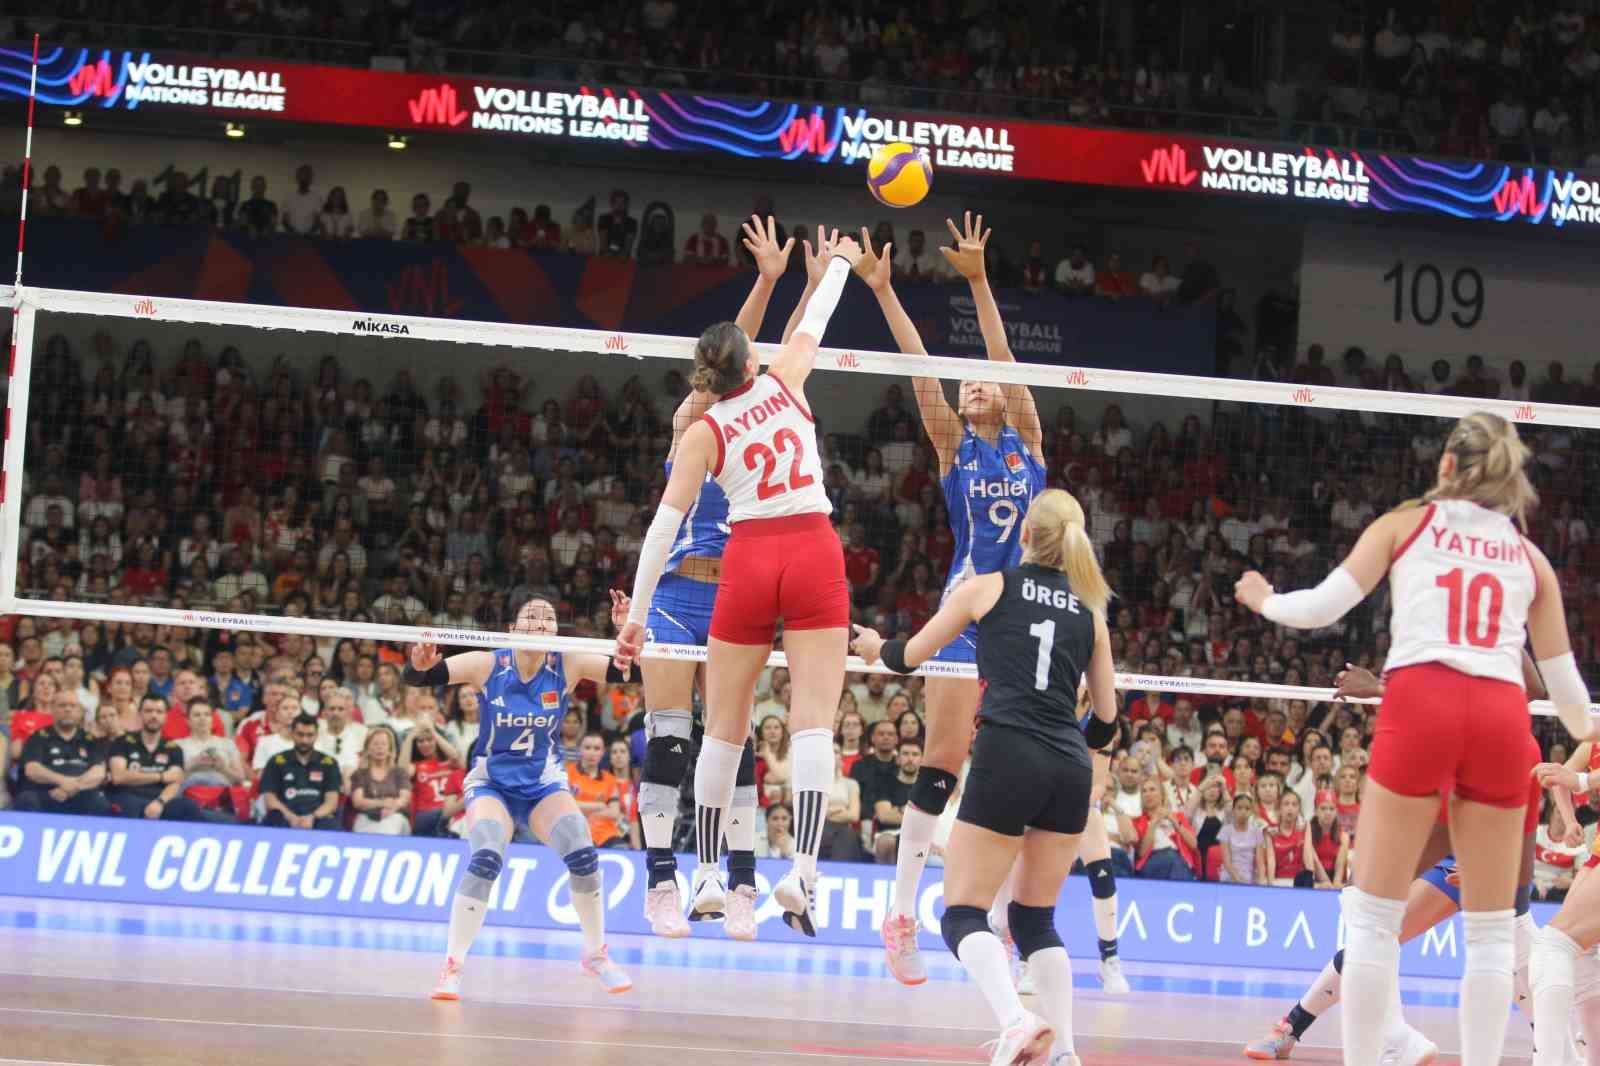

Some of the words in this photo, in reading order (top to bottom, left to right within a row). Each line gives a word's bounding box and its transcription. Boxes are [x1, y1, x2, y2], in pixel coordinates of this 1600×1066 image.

[127, 62, 286, 93] VOLLEYBALL
[125, 85, 209, 106] NATIONS
[212, 93, 285, 112] LEAGUE
[408, 84, 468, 126] VNL
[473, 86, 650, 122] VOLLEYBALL
[472, 112, 564, 135] NATIONS
[569, 120, 649, 142] LEAGUE
[842, 115, 1015, 151] VOLLEYBALL
[936, 151, 1014, 171] LEAGUE
[1141, 144, 1198, 186] VNL
[1203, 146, 1370, 183] VOLLEYBALL
[1201, 172, 1289, 195] NATIONS
[1294, 181, 1369, 203] LEAGUE
[133, 299, 157, 315] VNL
[1384, 259, 1485, 328] 109
[352, 317, 410, 335] MIKASA
[604, 335, 629, 351] VNL
[836, 352, 860, 368] VNL
[1066, 369, 1088, 385] VNL
[743, 427, 815, 500] 22
[988, 499, 1018, 543] 9
[1022, 578, 1080, 614] ÖRGE
[1435, 568, 1504, 649] 10
[1029, 619, 1056, 691] 1
[496, 712, 555, 727] Haier
[510, 728, 535, 757] 4
[37, 828, 128, 888] VNL
[144, 835, 460, 907] COLLECTION
